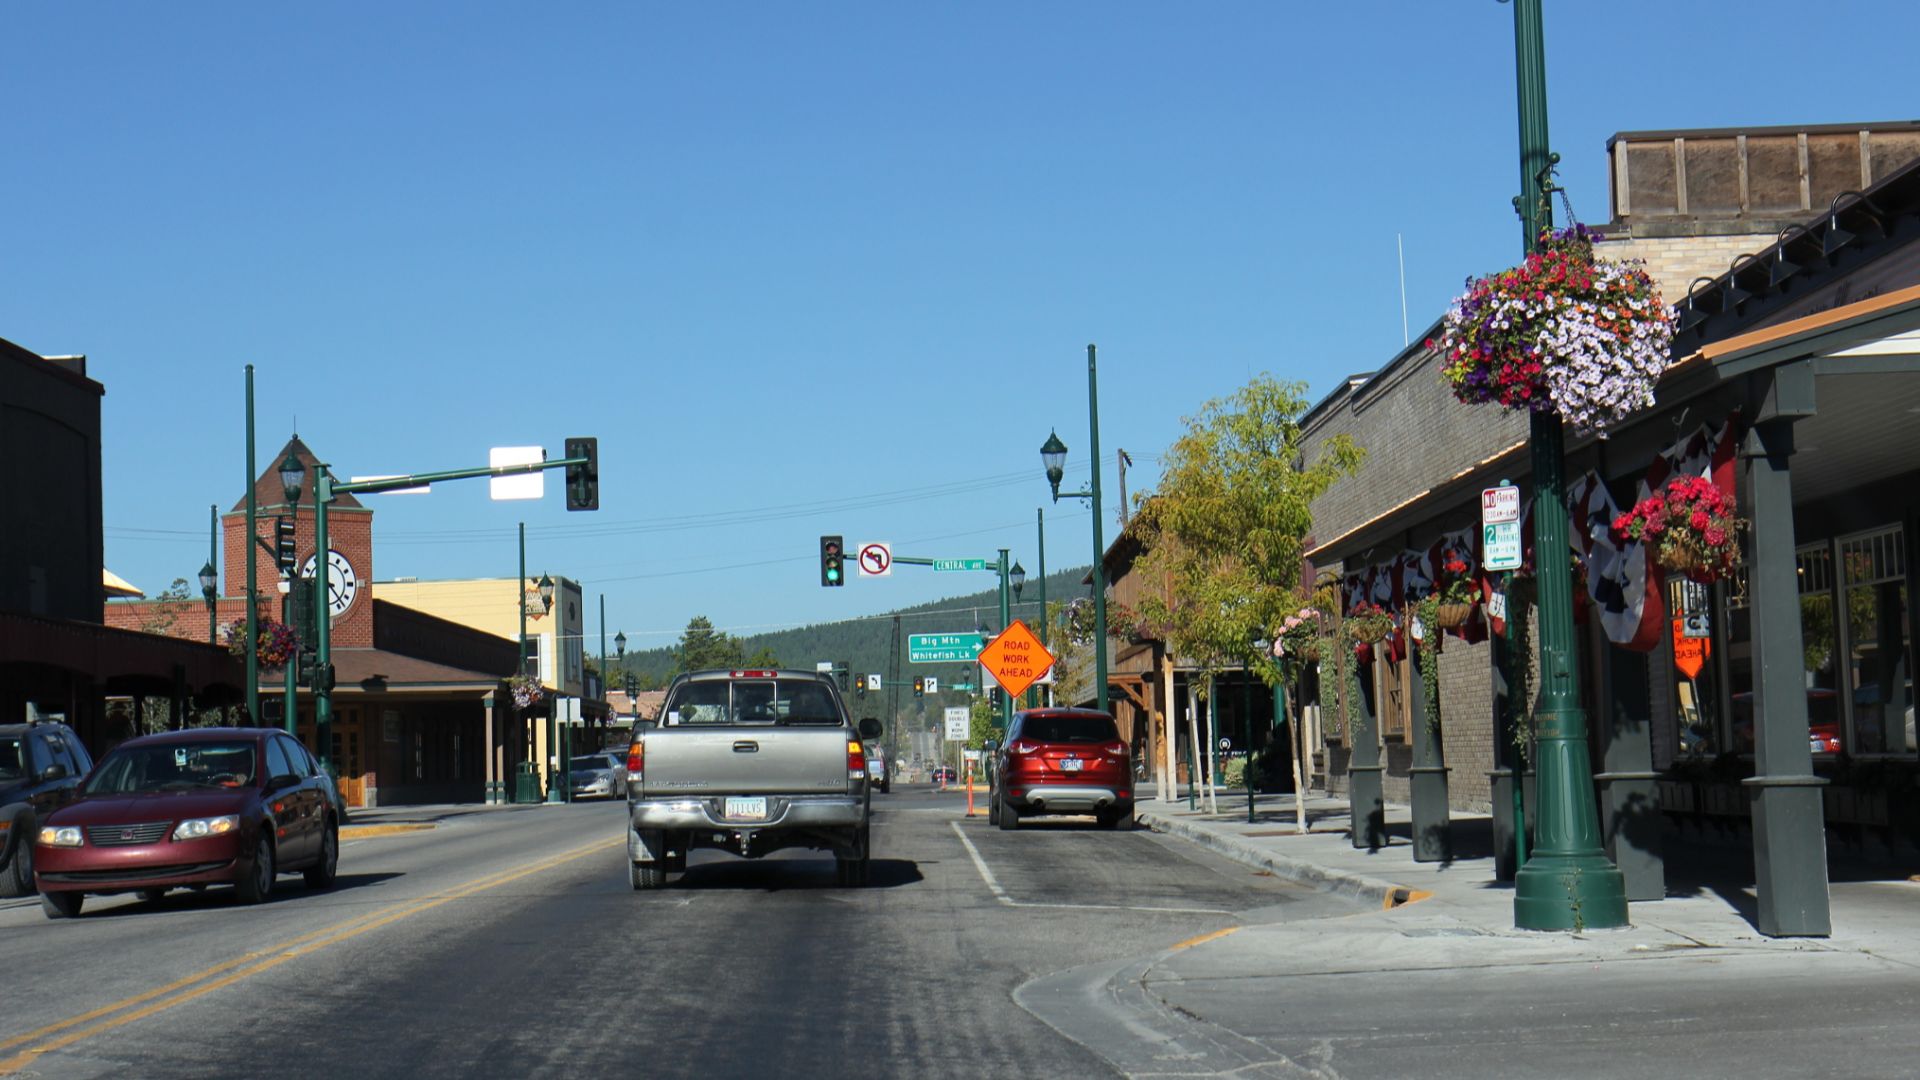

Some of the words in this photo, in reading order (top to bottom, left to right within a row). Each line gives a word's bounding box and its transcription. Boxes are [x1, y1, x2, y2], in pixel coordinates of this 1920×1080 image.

[1484, 493, 1496, 508] NO
[1497, 493, 1516, 504] PARKING
[1486, 526, 1495, 544] 2
[1497, 533, 1518, 542] PARKING
[936, 560, 967, 570] CENTRAL
[921, 637, 937, 647] Big
[941, 636, 960, 645] Mtn
[1004, 640, 1030, 651] ROAD
[912, 651, 955, 660] Whitefish
[959, 650, 970, 659] Lk
[1003, 654, 1029, 664] WORK
[999, 667, 1033, 678] AHEAD
